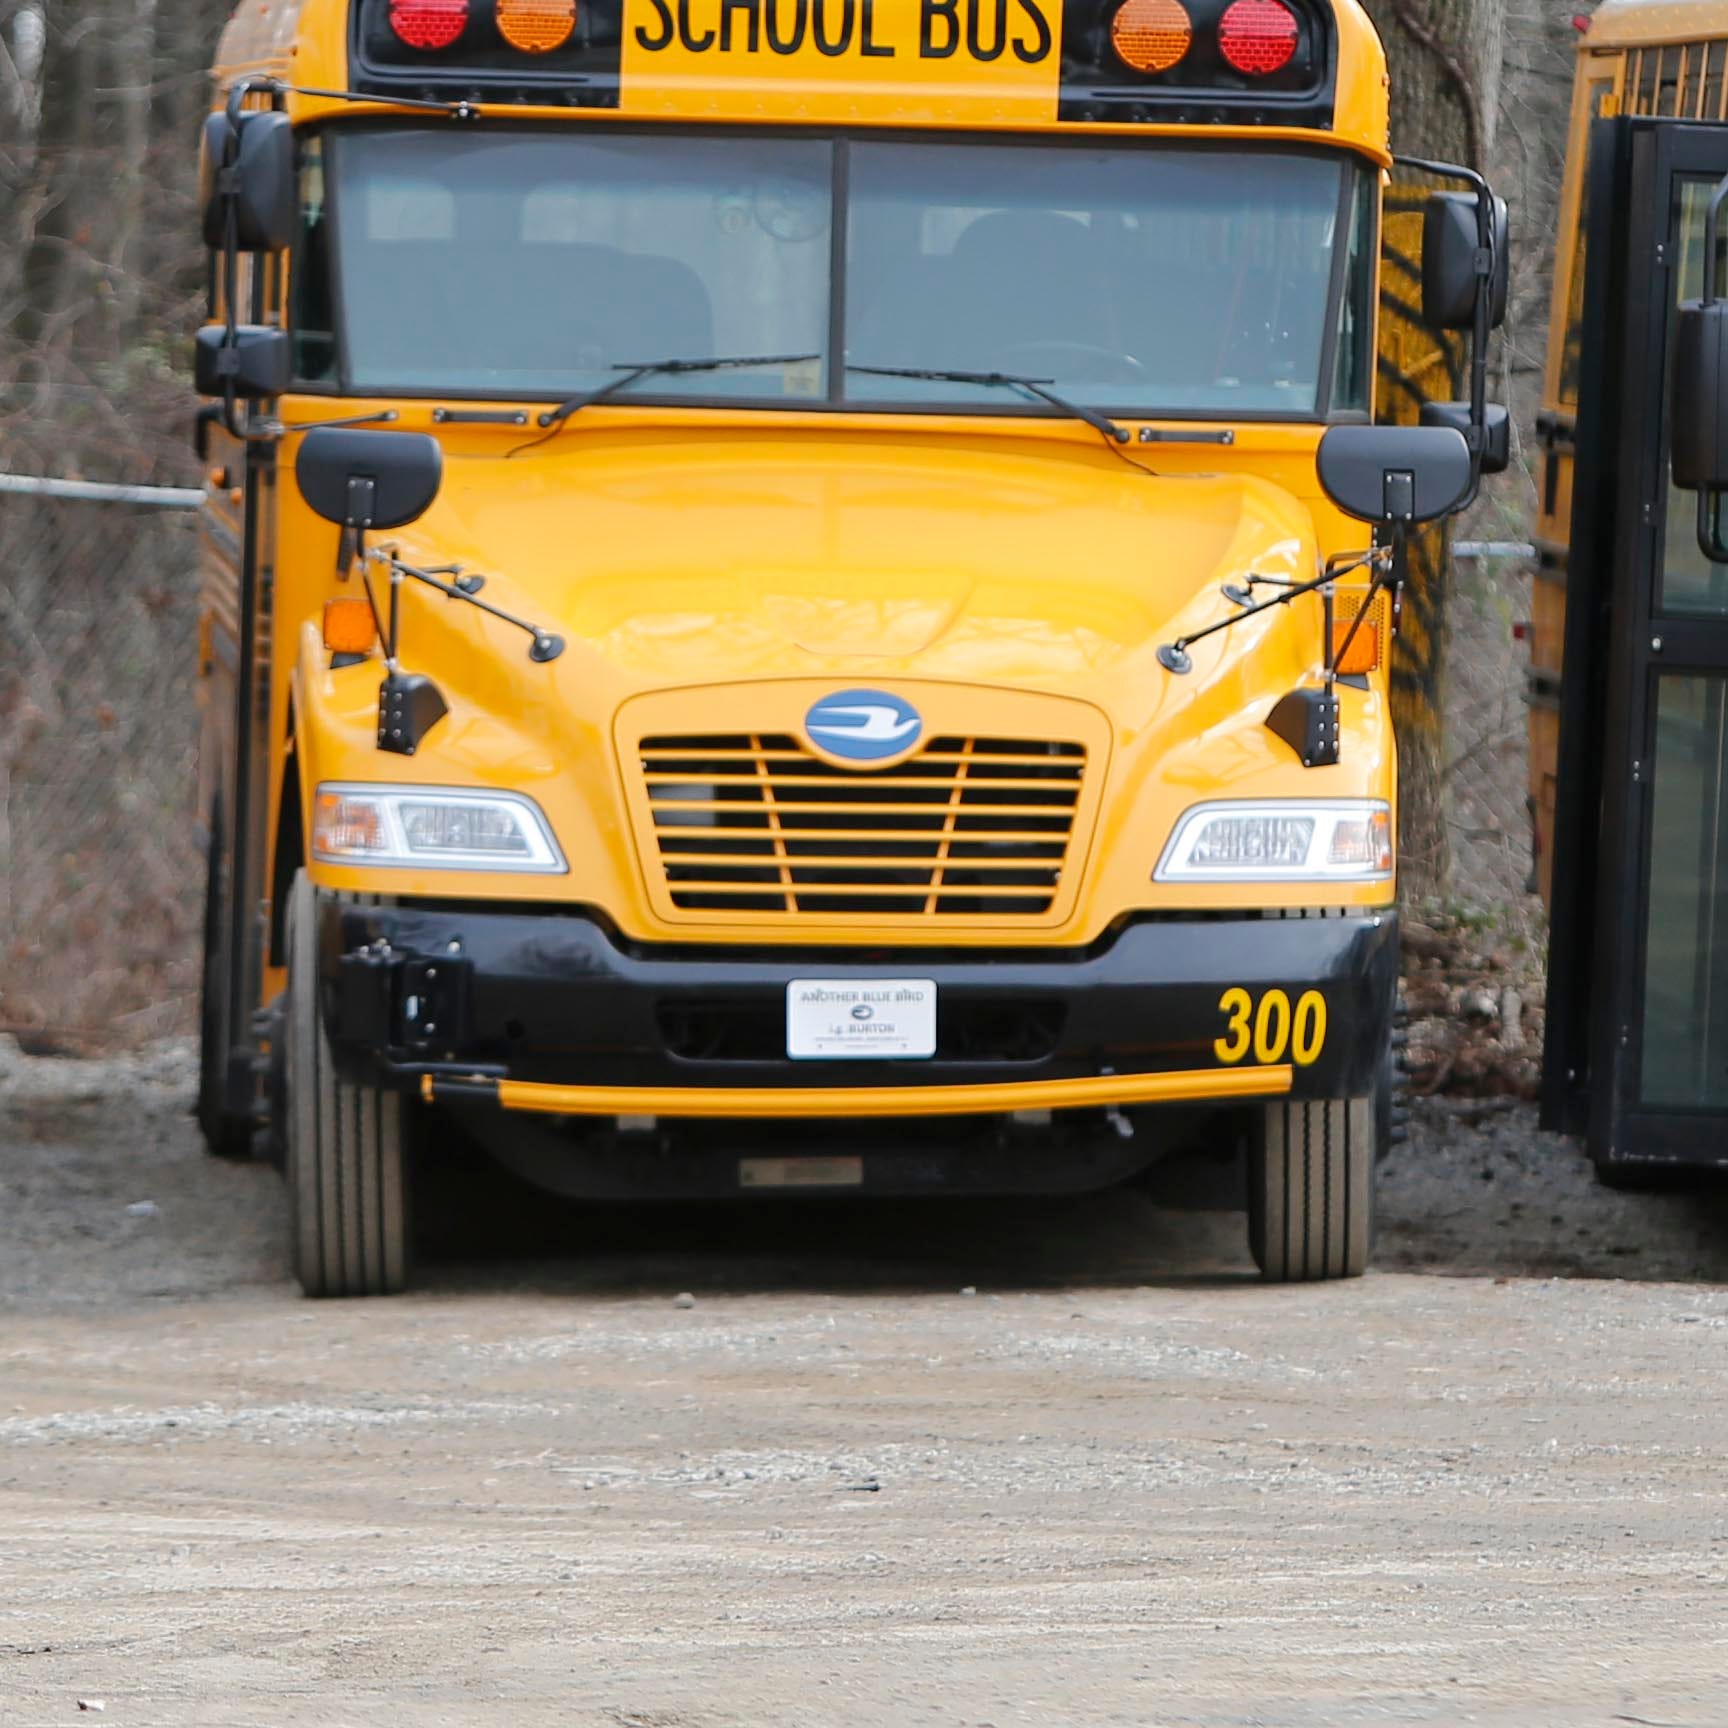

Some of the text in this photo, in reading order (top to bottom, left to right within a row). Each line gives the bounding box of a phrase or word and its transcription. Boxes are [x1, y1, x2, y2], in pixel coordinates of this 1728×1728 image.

[801, 989, 924, 1002] ANOTHER BLUE BIRD
[848, 1023, 895, 1033] BURTON
[1214, 987, 1327, 1066] 300
